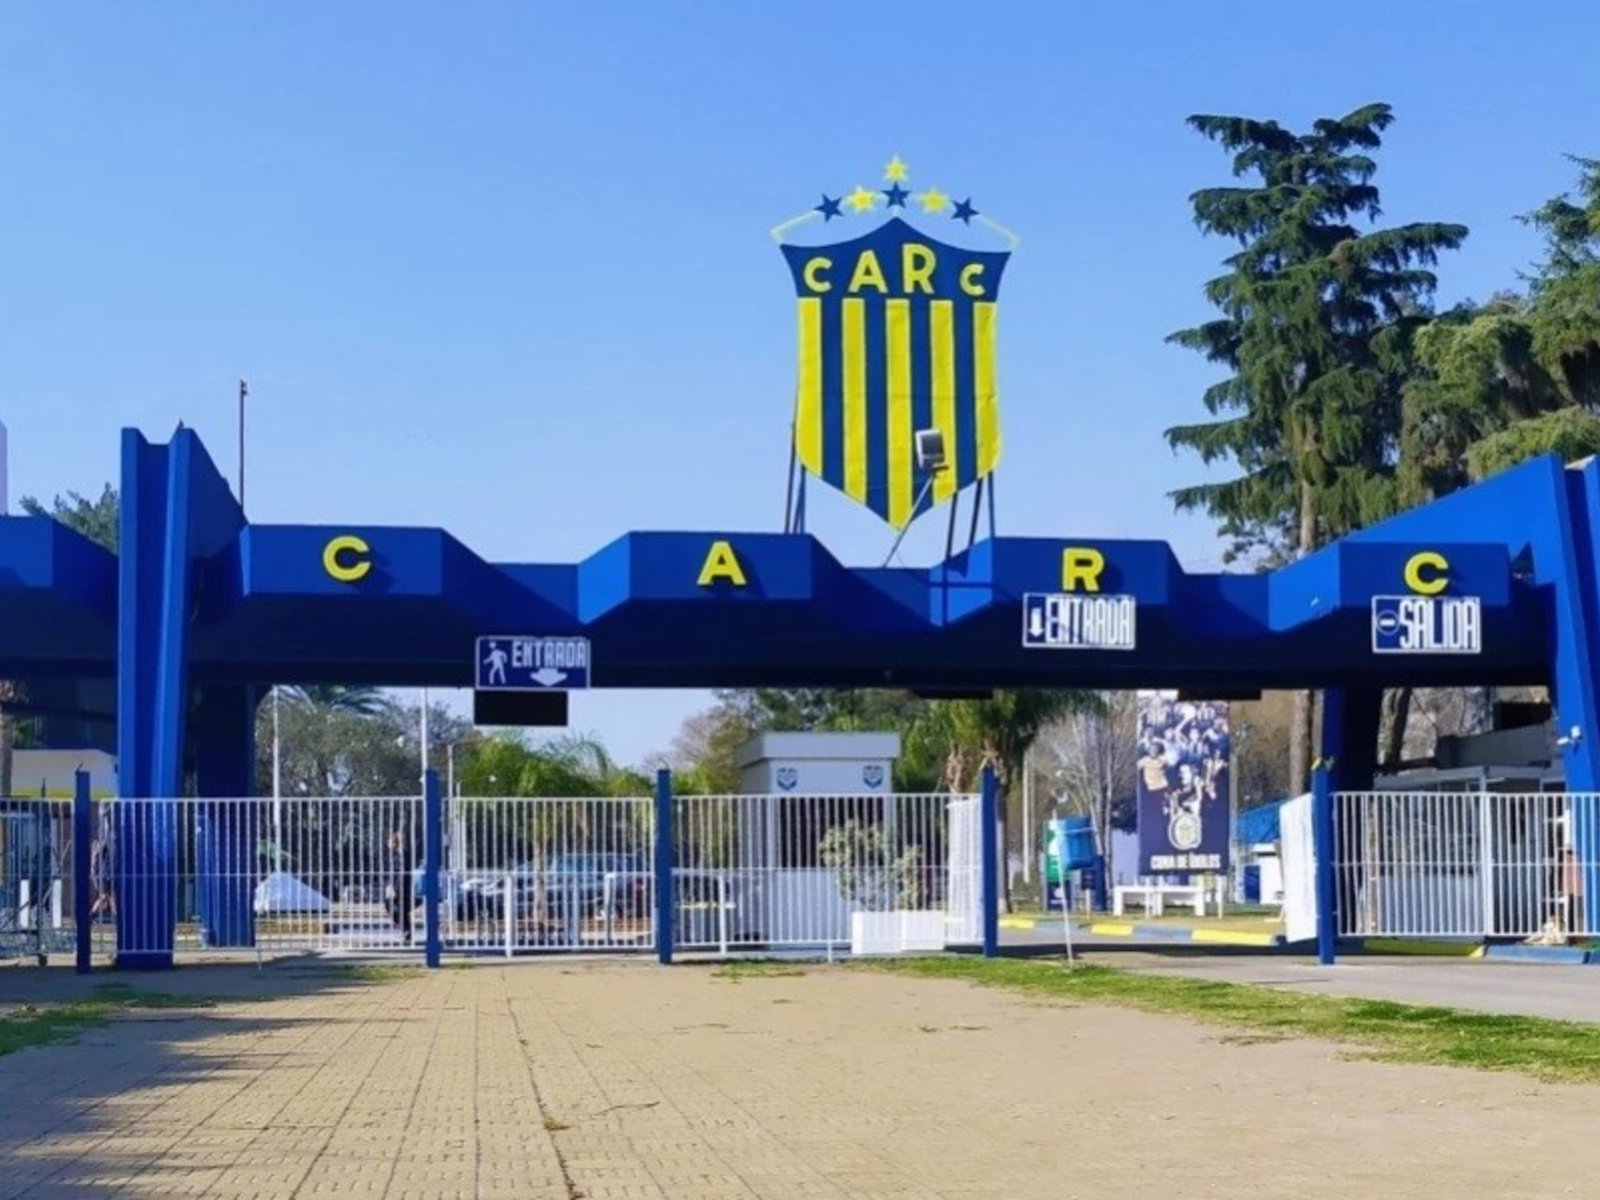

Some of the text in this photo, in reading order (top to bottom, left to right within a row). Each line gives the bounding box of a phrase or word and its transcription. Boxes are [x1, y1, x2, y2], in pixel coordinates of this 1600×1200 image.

[323, 536, 1449, 594] C A R C
[1045, 597, 1132, 645] ENTRADA
[1399, 599, 1477, 648] SALIDA
[511, 641, 587, 668] ENTRADA
